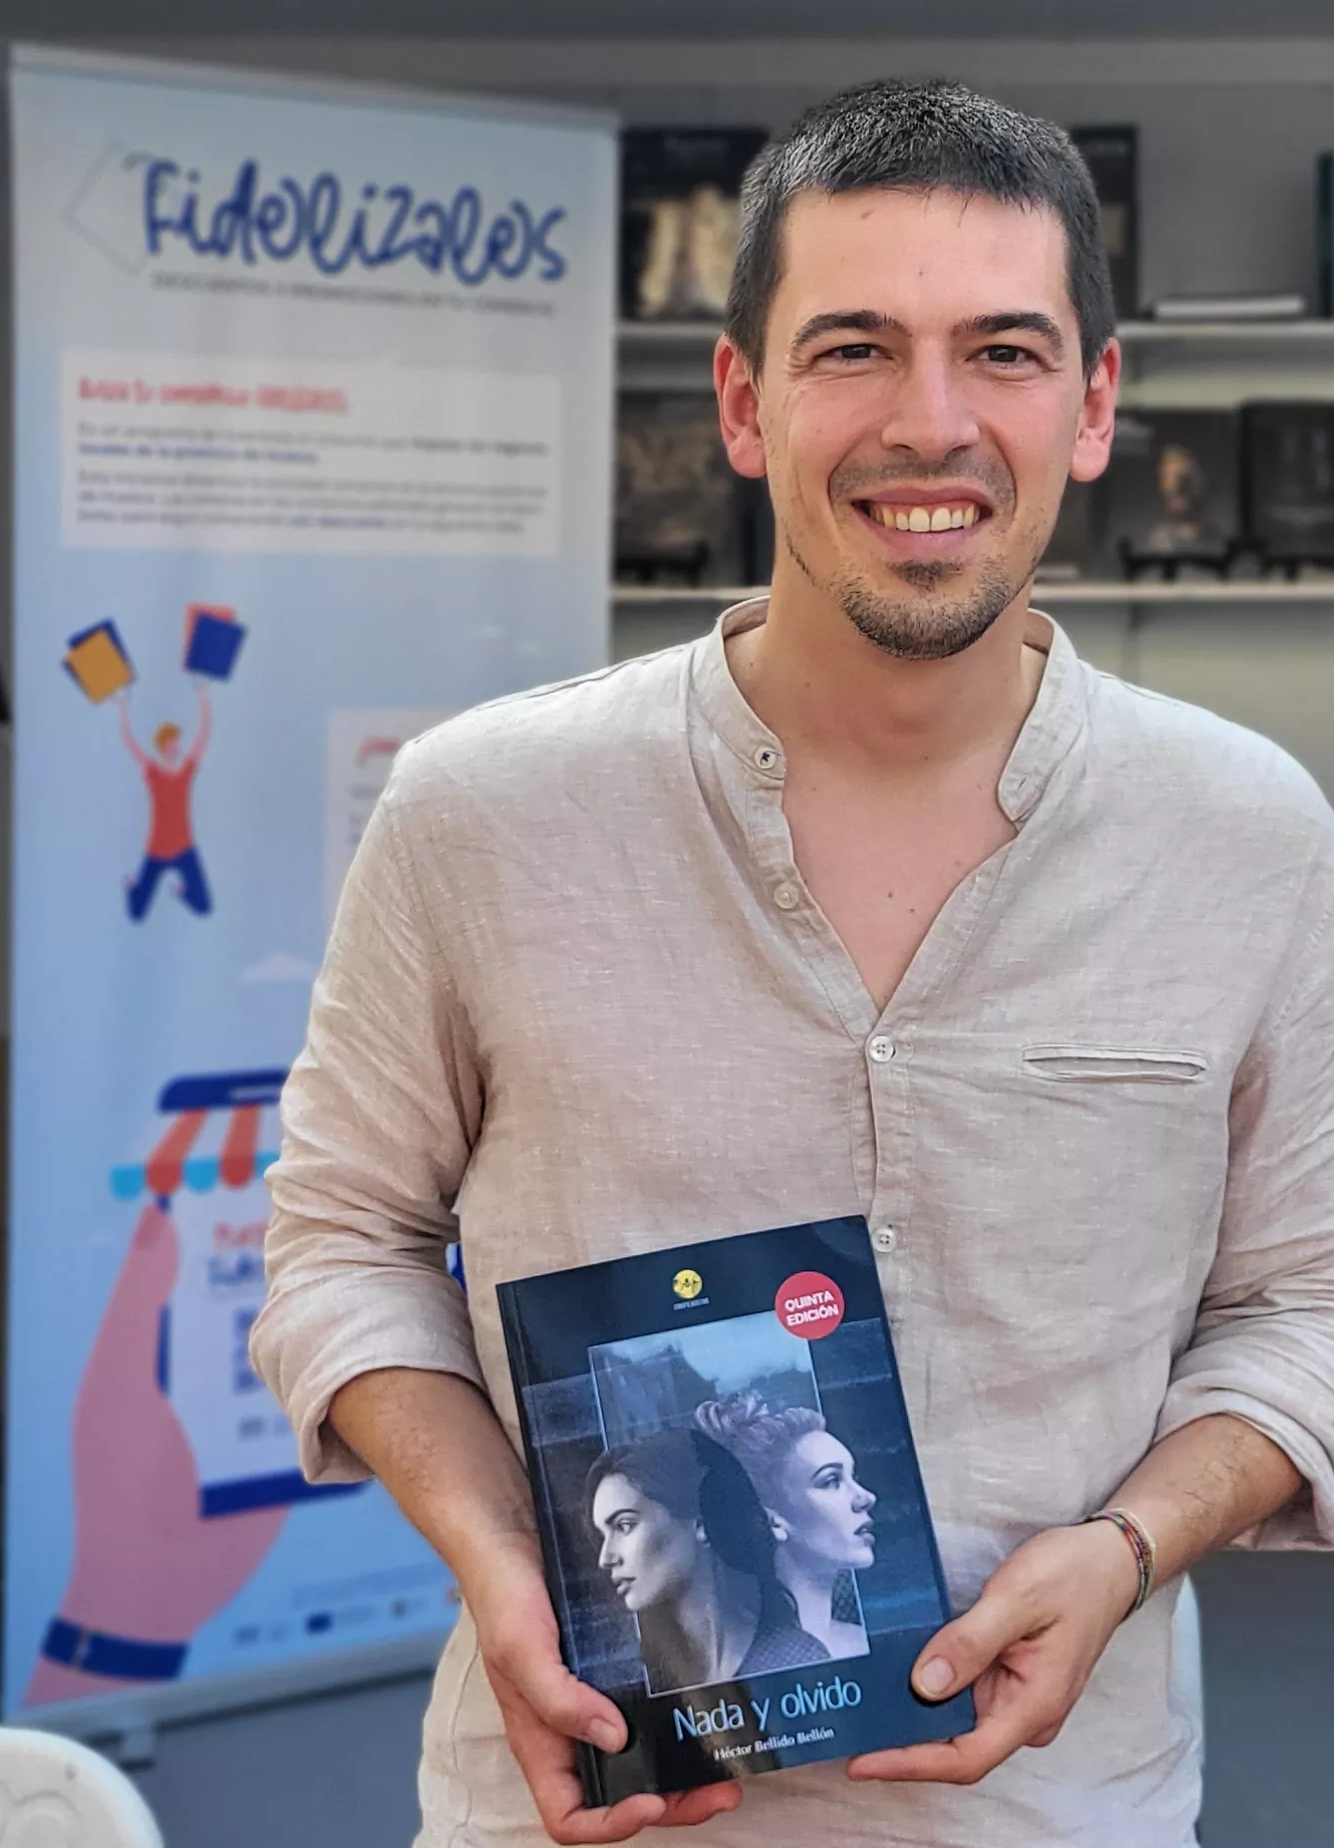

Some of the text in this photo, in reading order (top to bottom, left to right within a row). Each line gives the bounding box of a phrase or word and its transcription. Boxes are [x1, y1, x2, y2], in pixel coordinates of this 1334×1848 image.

[784, 1290, 835, 1312] QUINTA
[785, 1303, 839, 1327] EDICIÓN
[673, 1675, 862, 1741] Nada y olvido
[713, 1725, 835, 1761] Héctor Bellido Bellón
